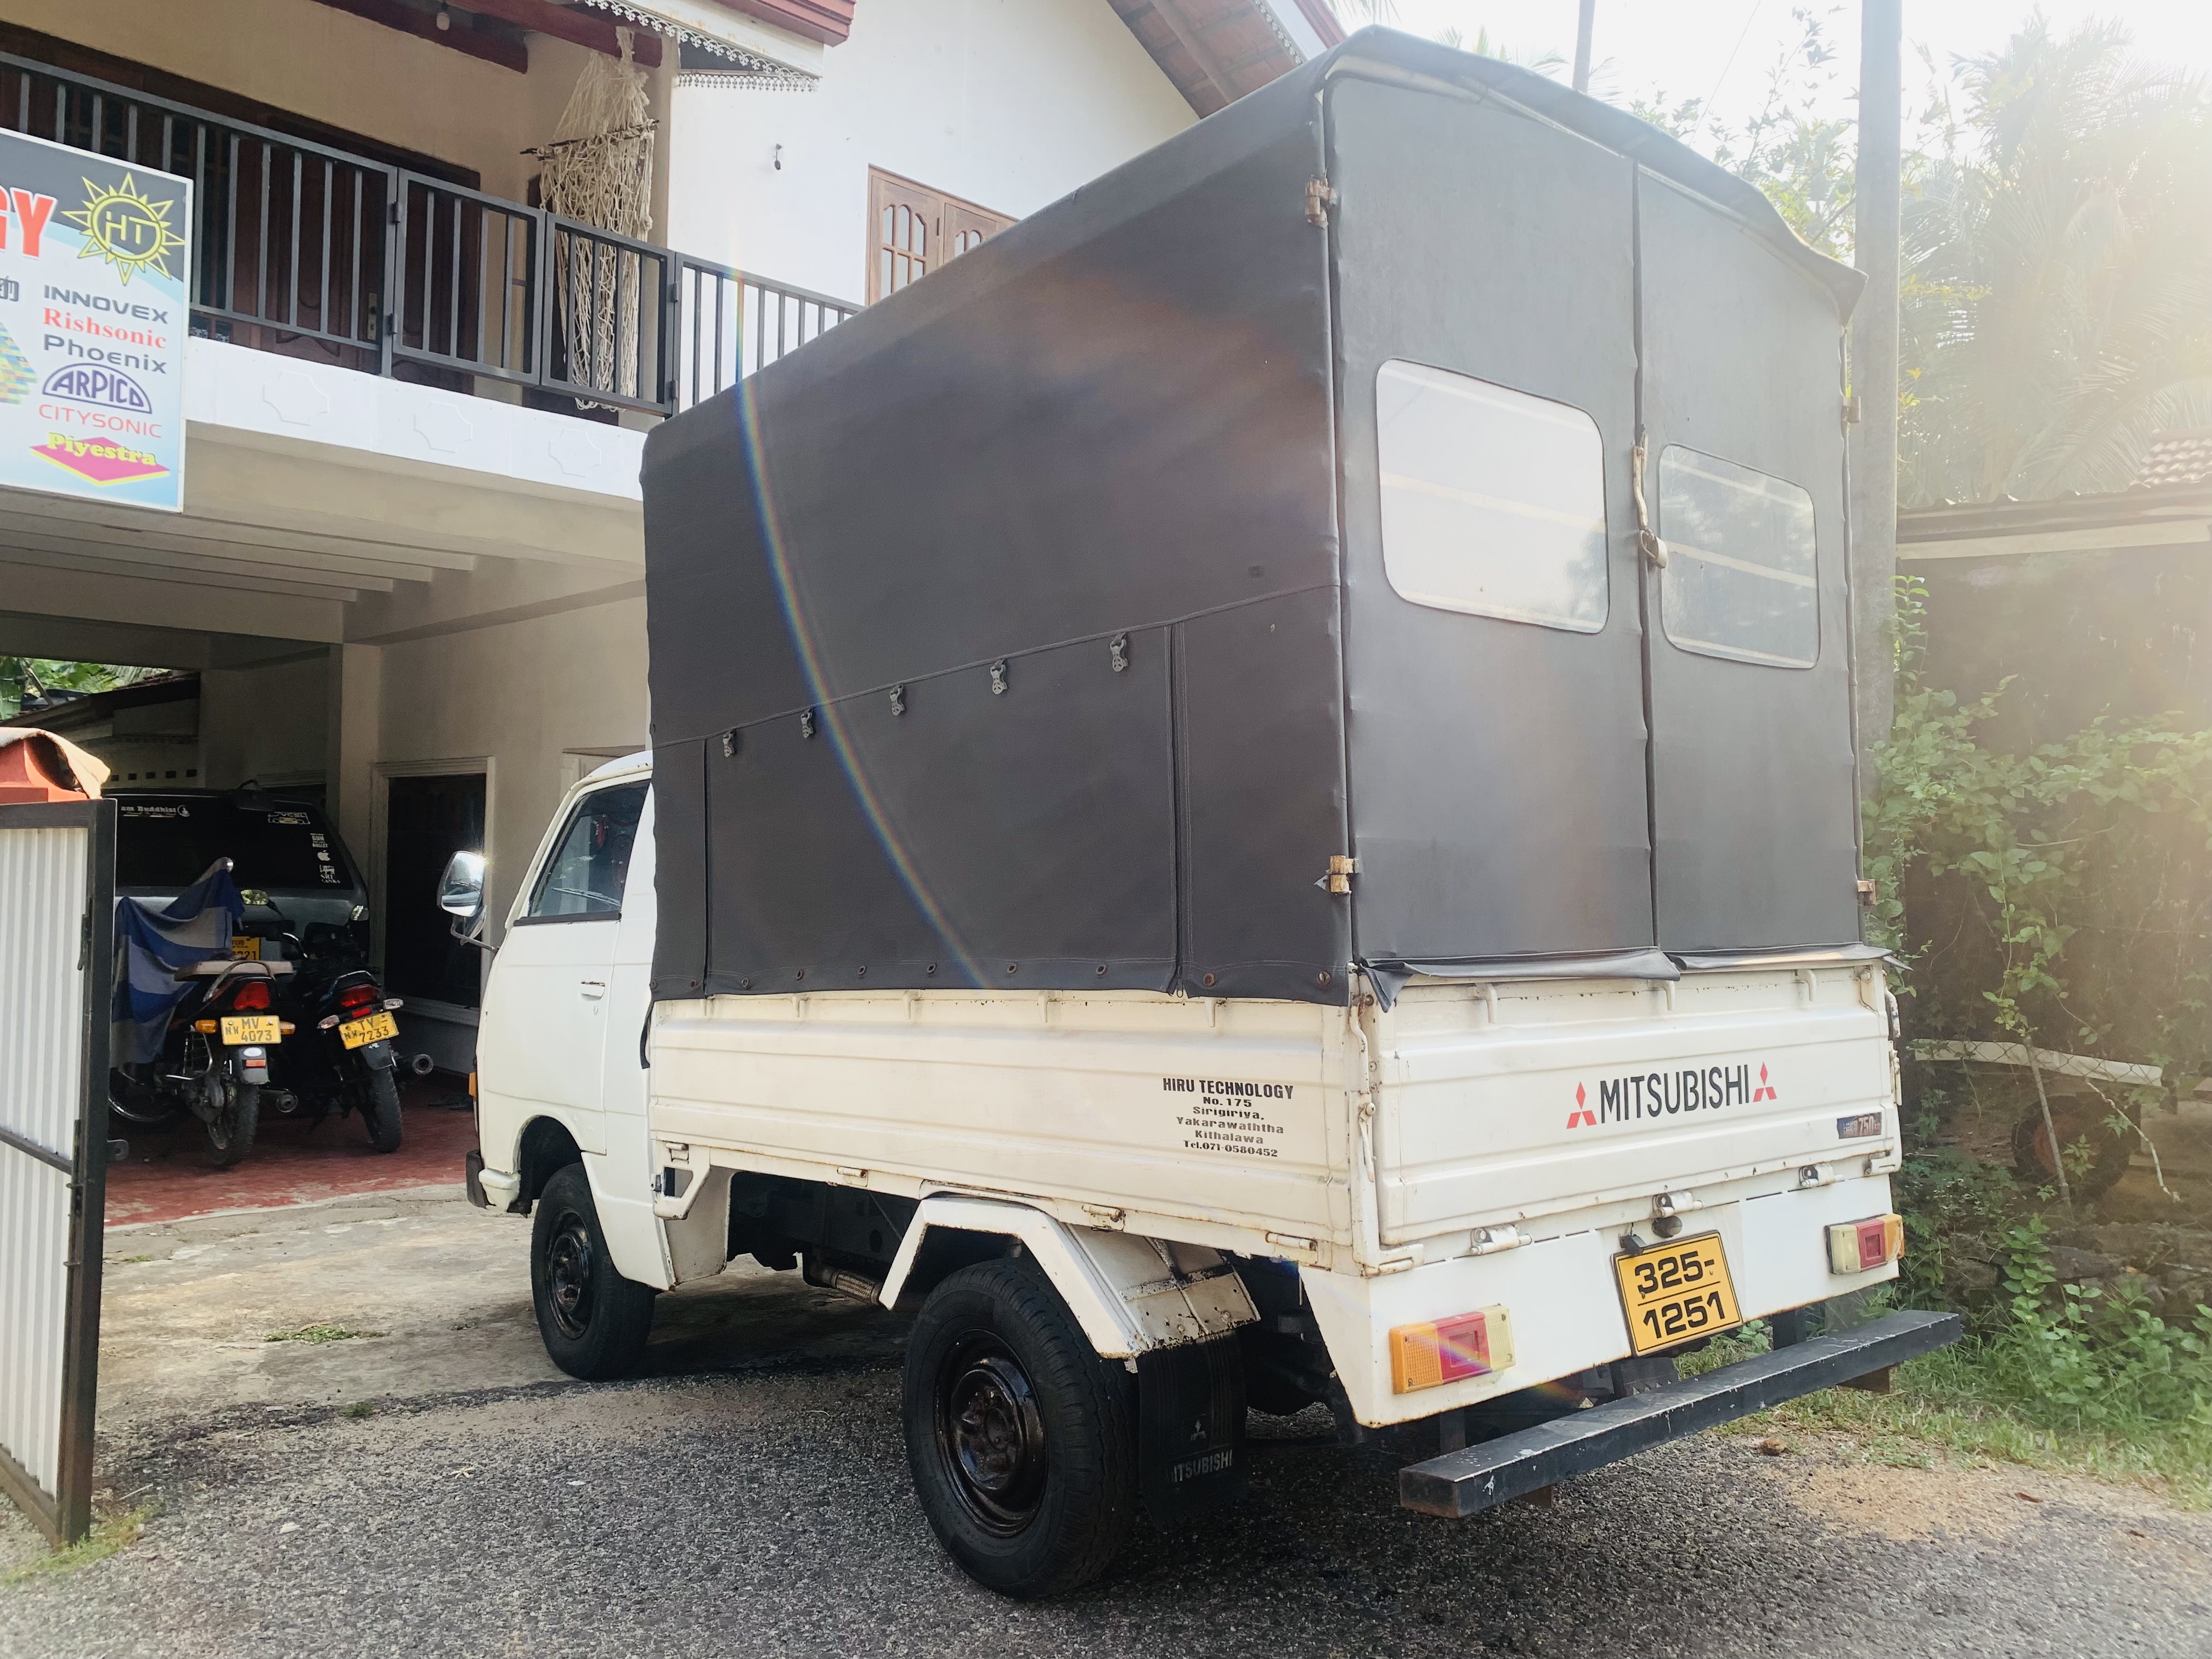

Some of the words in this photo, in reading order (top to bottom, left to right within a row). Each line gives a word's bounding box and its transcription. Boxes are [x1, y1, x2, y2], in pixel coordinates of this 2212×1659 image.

[0, 184, 58, 260] Y
[44, 285, 168, 325] INNOVEX
[43, 307, 167, 349] Rishsonic
[44, 334, 167, 374] Phoenix
[52, 369, 144, 407] ARPICO
[38, 404, 162, 438] CITYSONIC
[47, 432, 157, 466] Piyestra
[241, 1030, 272, 1042] 4073
[359, 1025, 389, 1042] 7233
[1163, 1078, 1194, 1092] HIRU
[1199, 1080, 1294, 1099] TECHNOLOGY
[1226, 1098, 1252, 1107] 175
[1600, 1064, 1750, 1124] MITSUBISHI
[1176, 1116, 1284, 1133] Yakarawaththa
[1195, 1130, 1263, 1144] Kithalawa
[1643, 1291, 1725, 1339] 1251
[1172, 1449, 1232, 1482] ITSUBISHI
